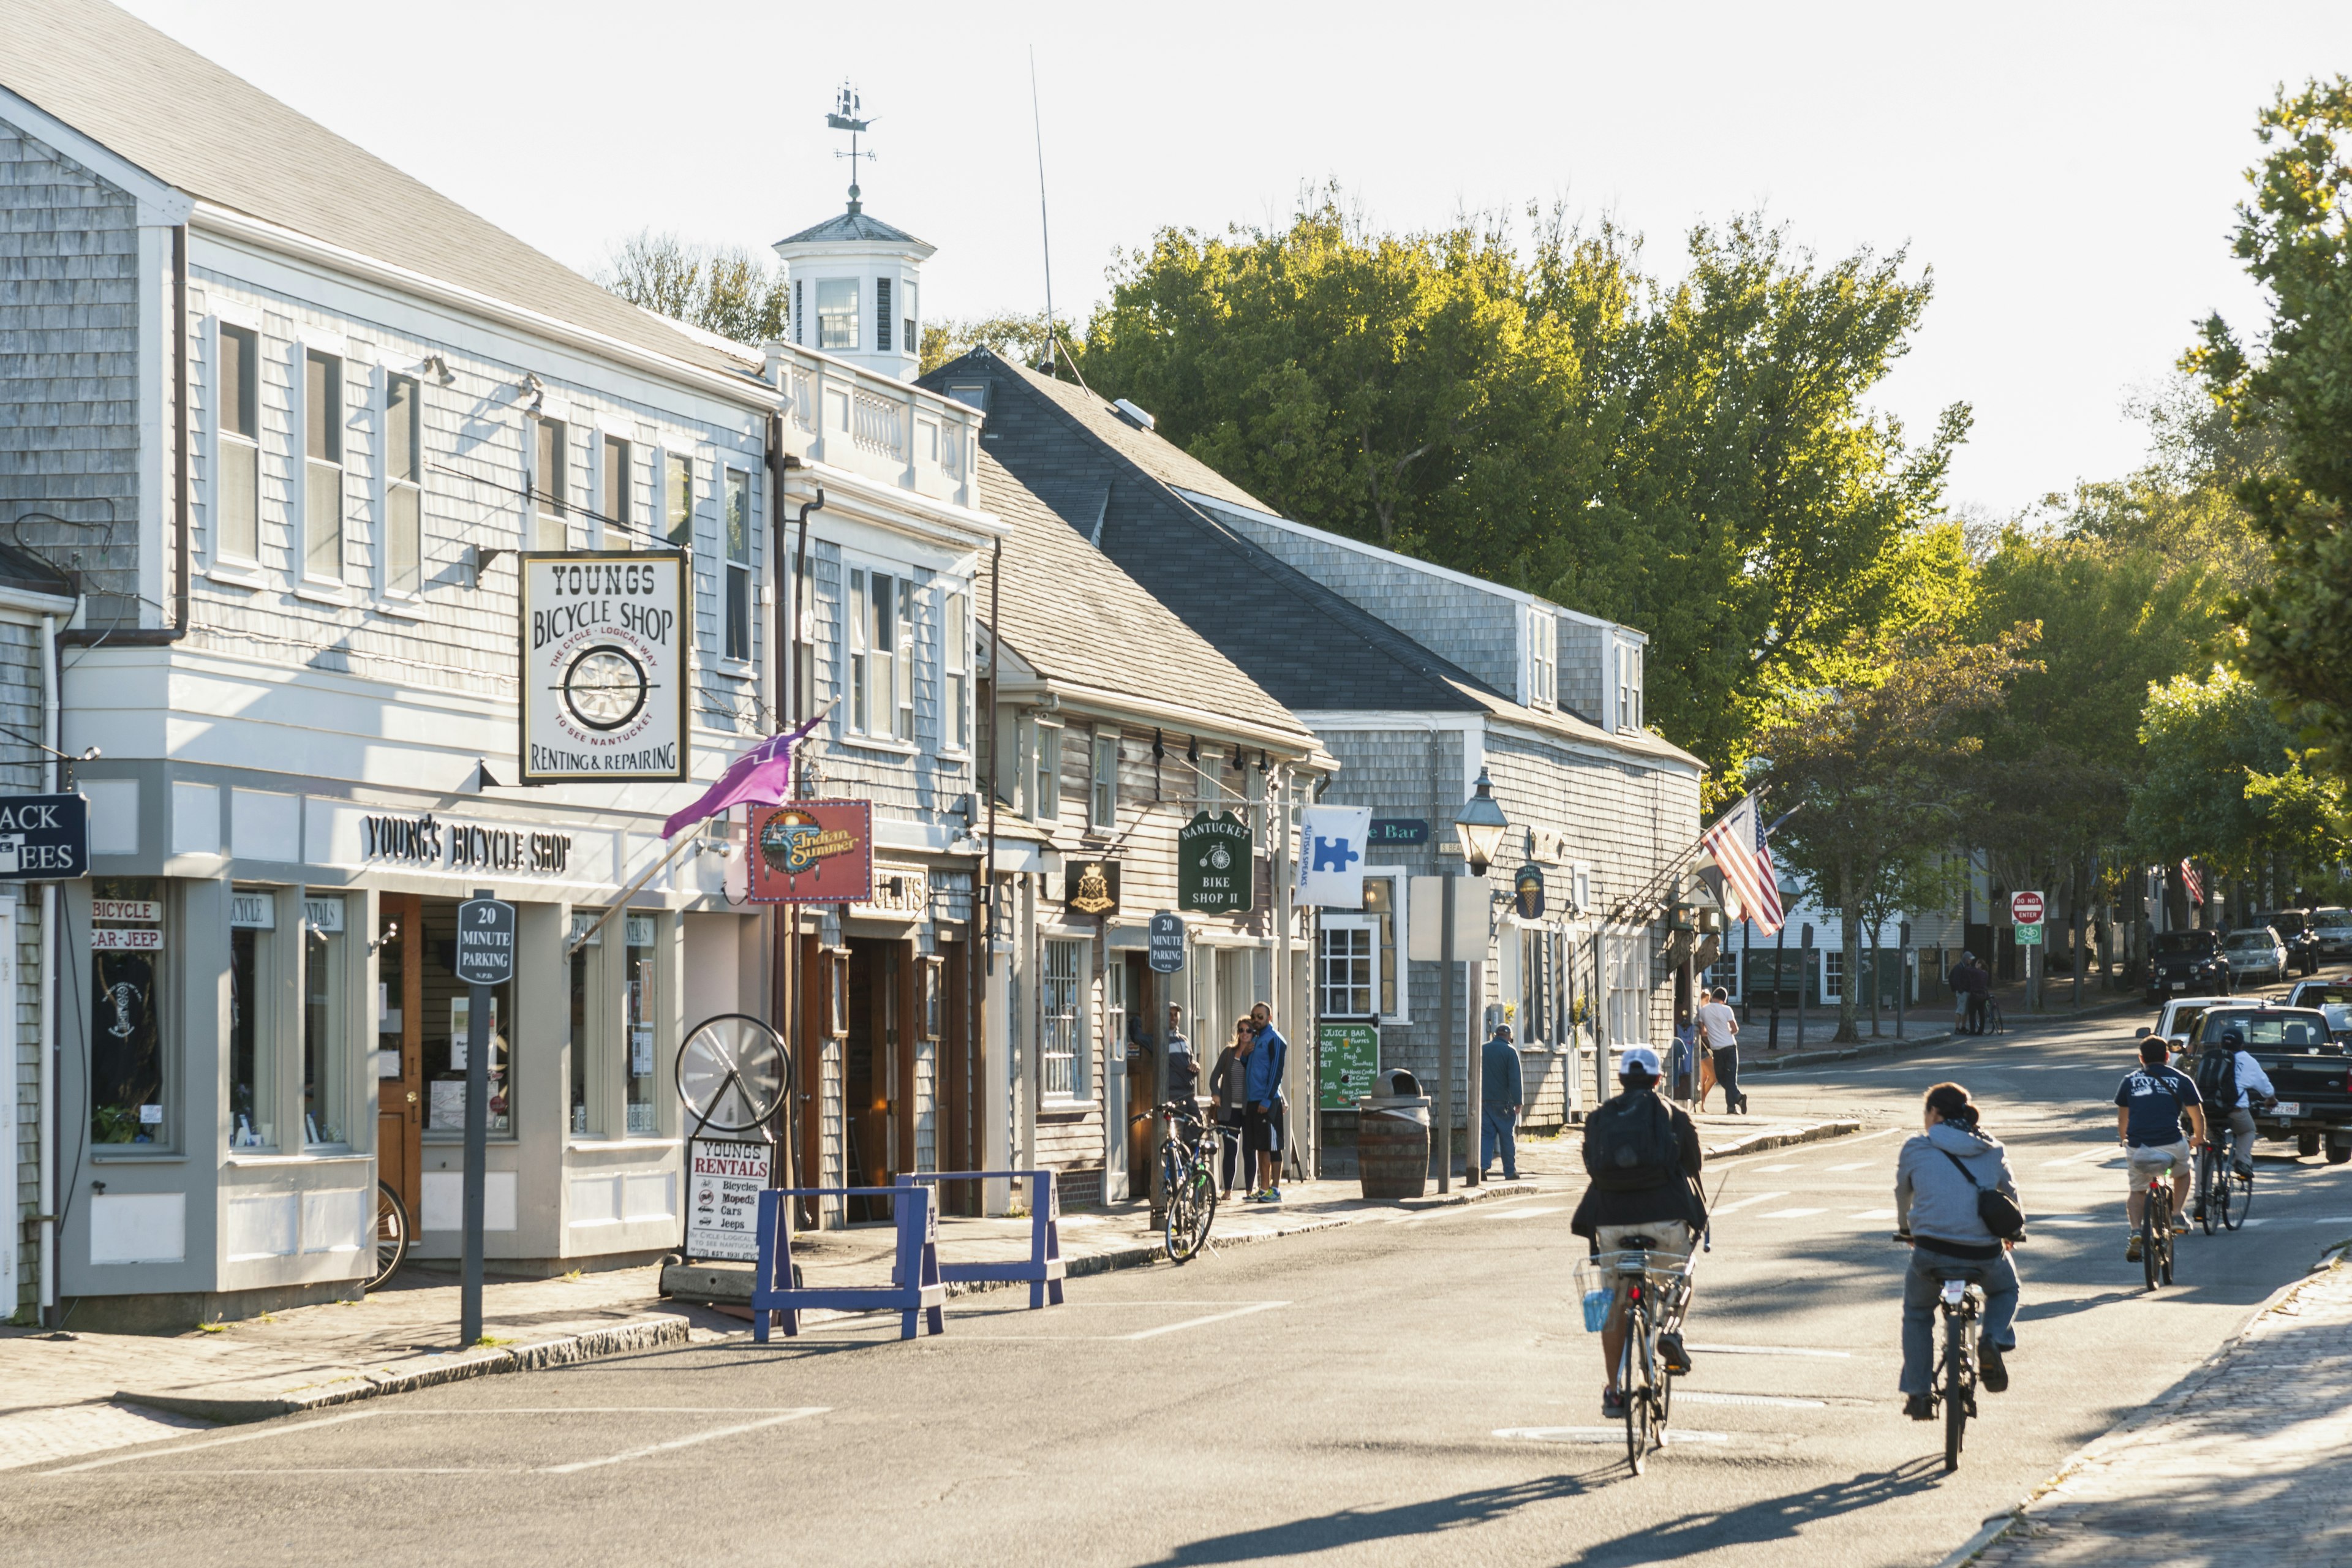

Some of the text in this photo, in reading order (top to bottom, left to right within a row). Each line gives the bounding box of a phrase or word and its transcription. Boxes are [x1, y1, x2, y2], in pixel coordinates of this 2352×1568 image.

[552, 565, 655, 595] YOUNGS
[534, 600, 673, 650] BICYCLE SHOP
[550, 627, 658, 668] THE CYCLE LOGICAL WAY
[555, 712, 653, 745] TO SEE NANTUCKET
[531, 742, 676, 771] RENTING & REPAIRING
[793, 830, 851, 848] Indian
[1384, 824, 1418, 839] Bar
[367, 813, 571, 872] YOUNG'S BICYCLE SHOP
[791, 837, 859, 865] Summer
[1300, 824, 1311, 886] AUTISM SPEAKS
[1202, 877, 1230, 888] BIKE
[1193, 893, 1223, 903] SHOP
[92, 902, 151, 919] BICYCLE
[478, 907, 496, 924] 20
[1162, 919, 1173, 931] 20
[462, 930, 511, 946] MINUTE
[1152, 935, 1182, 946] MINUTE
[462, 952, 508, 968] PARKING
[1153, 950, 1181, 960] PARKING
[704, 1142, 761, 1159] YOUNGS
[695, 1158, 767, 1177] RENTALS
[723, 1180, 758, 1192] Bicycles
[722, 1194, 755, 1205] Mopeds
[721, 1206, 742, 1216] Cars
[721, 1218, 744, 1230] Jeeps
